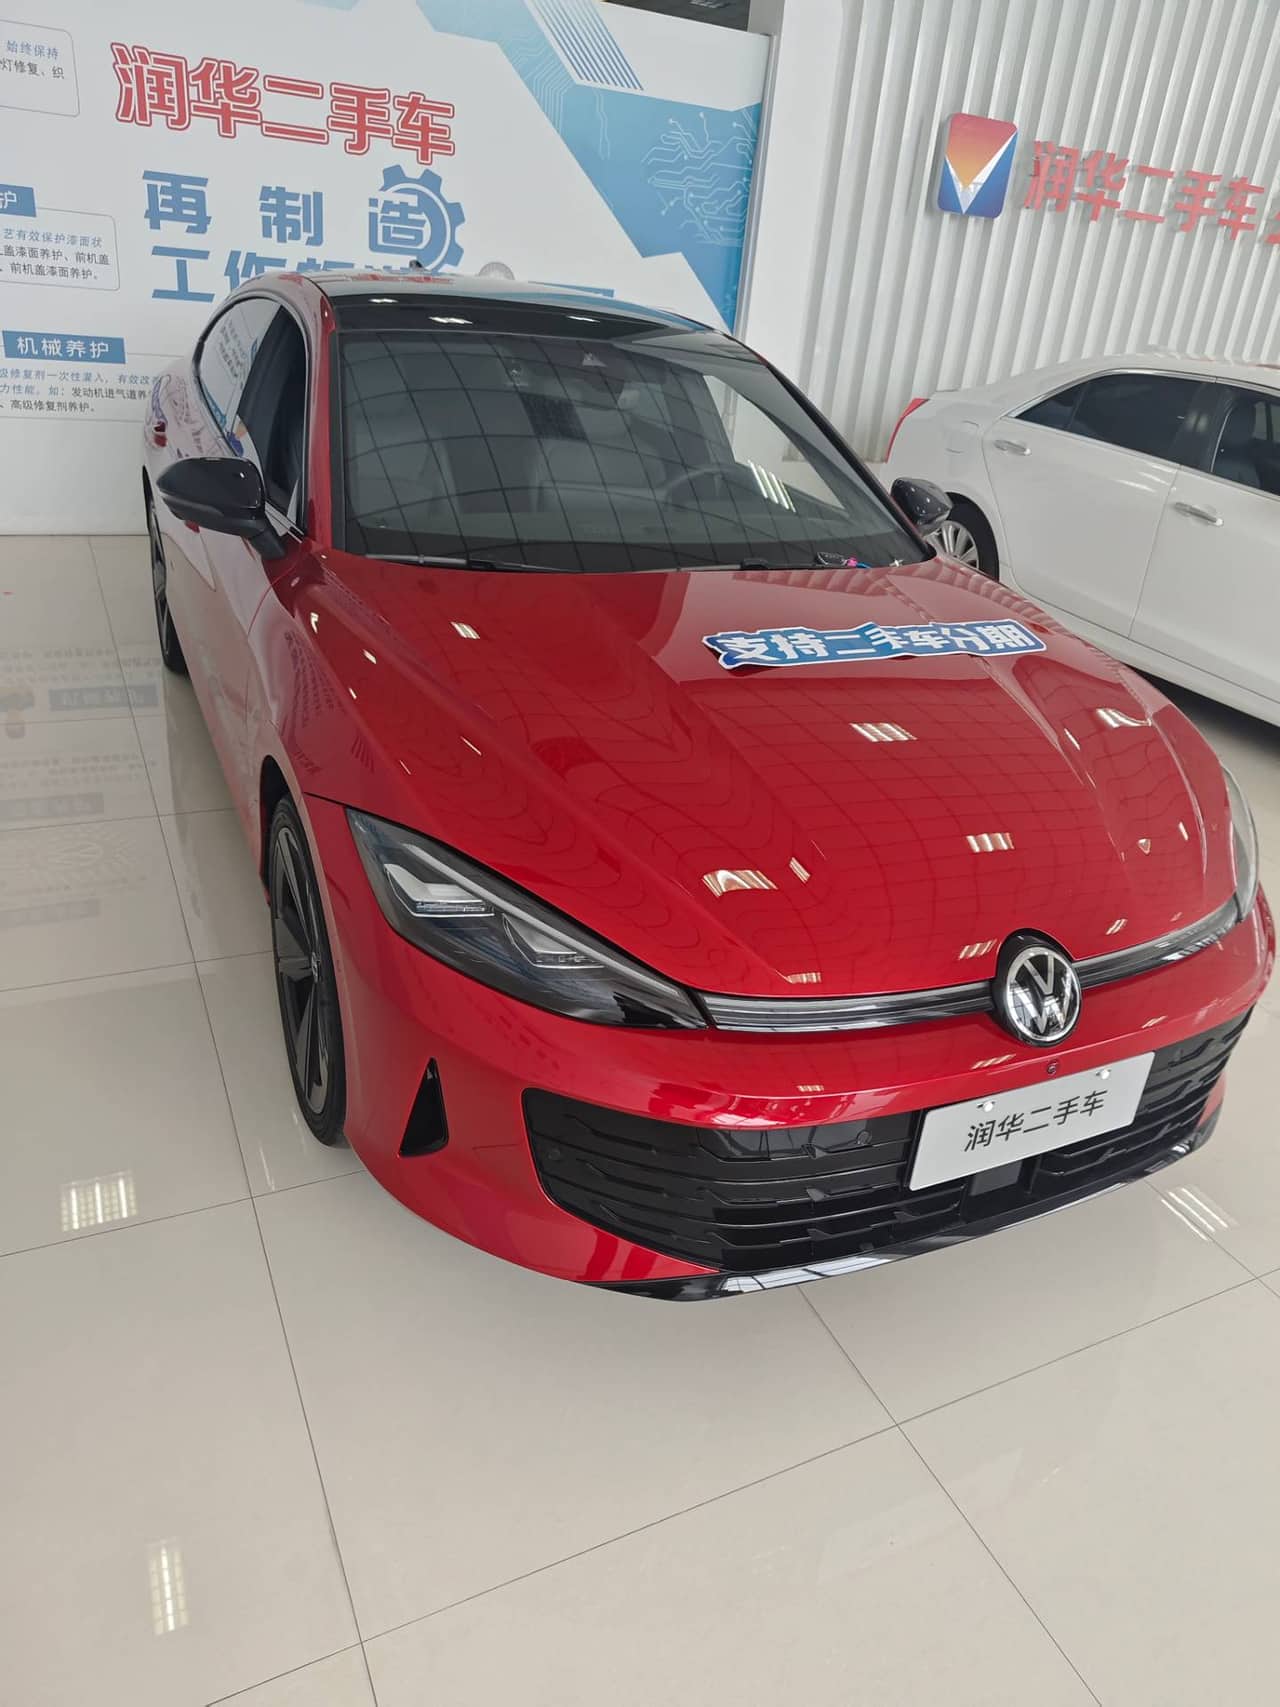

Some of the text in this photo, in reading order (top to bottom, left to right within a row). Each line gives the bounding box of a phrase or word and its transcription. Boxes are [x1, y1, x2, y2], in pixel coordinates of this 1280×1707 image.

[0, 57, 65, 80] 灯修复、织
[110, 42, 456, 166] 润华二手车
[1023, 140, 1280, 244] 润华二手车
[0, 244, 111, 266] 盖漆面养护、前机盖
[17, 336, 109, 359] 机械养护
[0, 384, 154, 400] 力性能。如：发动机进气道养
[719, 624, 1036, 661] 支持二手车分期
[964, 1090, 1108, 1152] 润华二手车
